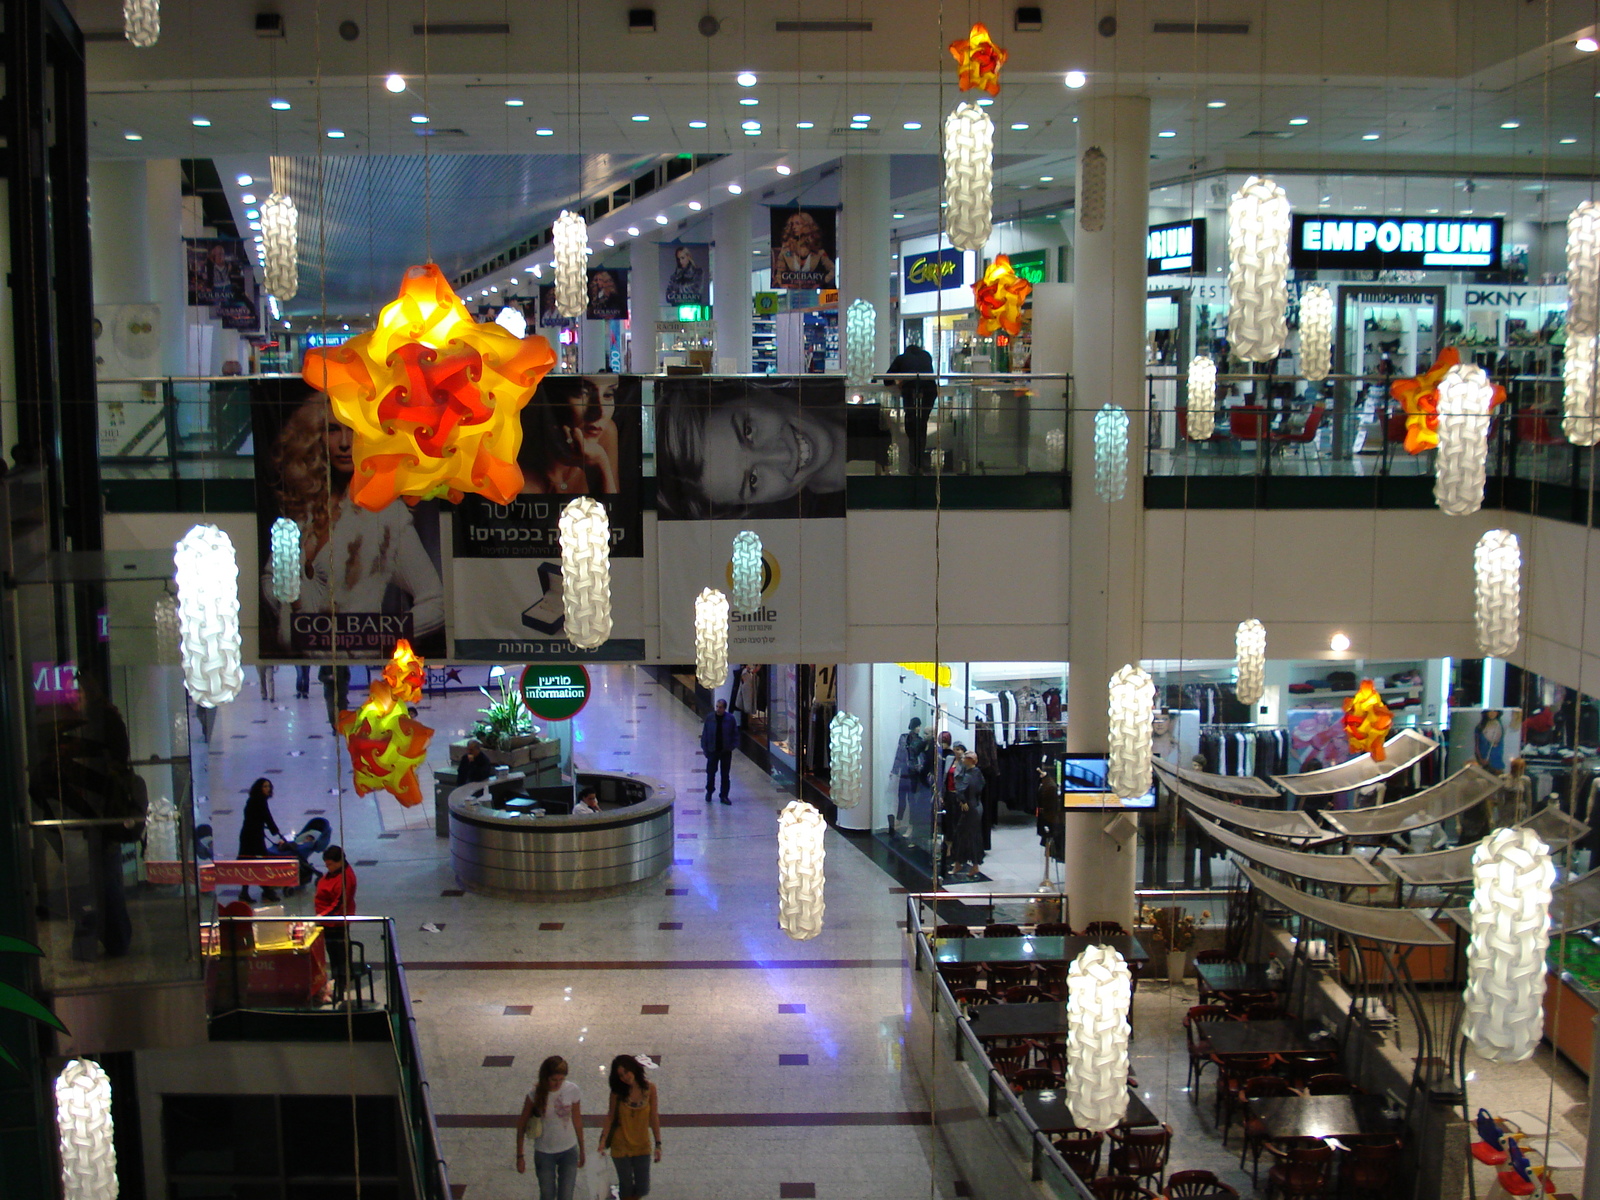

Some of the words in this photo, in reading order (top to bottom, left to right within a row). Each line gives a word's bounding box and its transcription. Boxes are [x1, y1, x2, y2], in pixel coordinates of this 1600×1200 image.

[1302, 221, 1492, 253] EMPORIUM
[781, 271, 825, 281] GOLBARY
[667, 293, 701, 301] GOLBARY
[1465, 291, 1528, 306] DKNY
[480, 500, 549, 519] סוליטר
[731, 606, 777, 622] smile
[293, 615, 409, 634] GOLBARY
[308, 634, 318, 646] 2
[366, 634, 396, 646] חדש
[497, 642, 545, 654] בחנות
[538, 674, 571, 687] מודיעין
[525, 687, 585, 699] information
